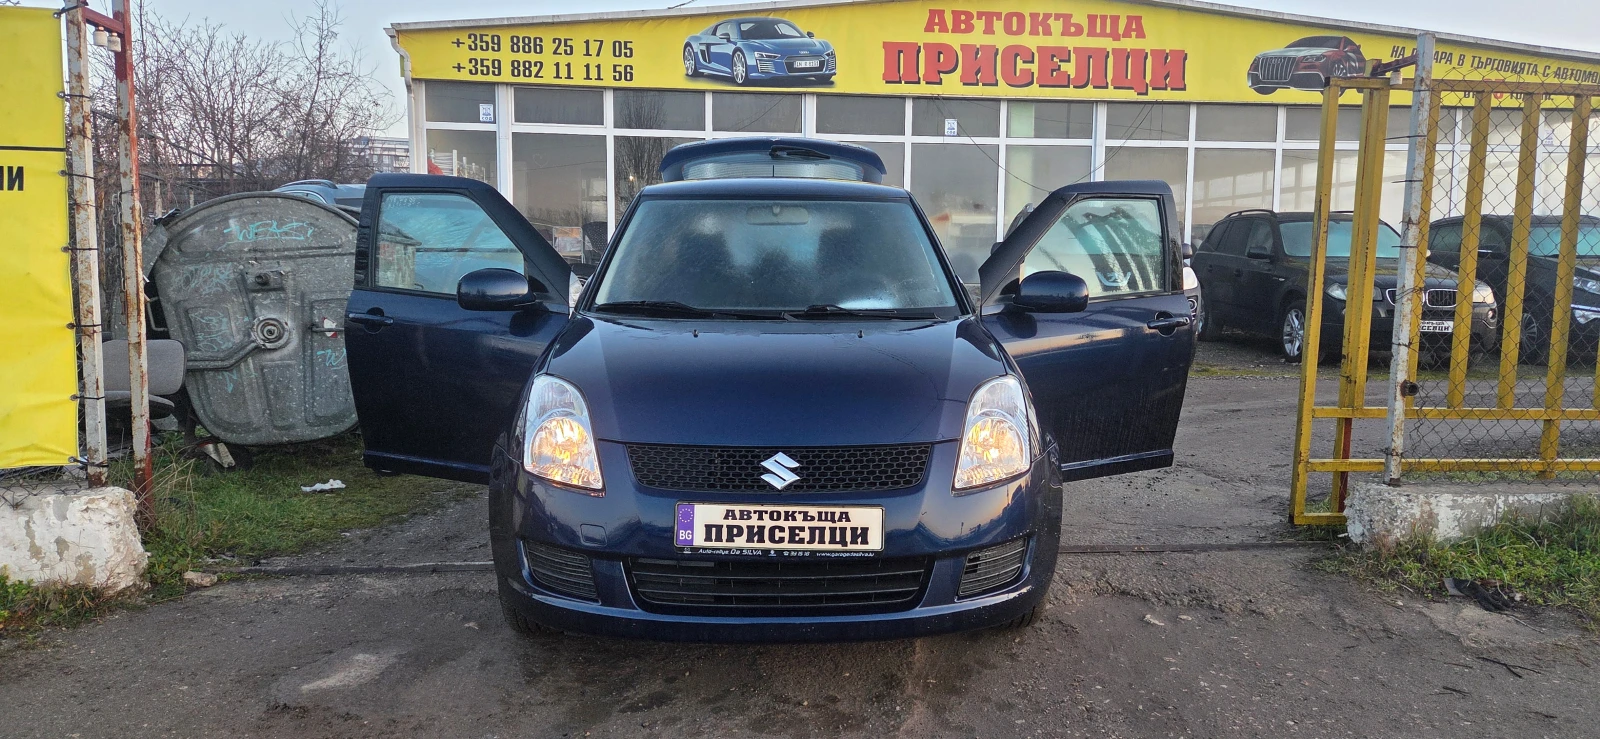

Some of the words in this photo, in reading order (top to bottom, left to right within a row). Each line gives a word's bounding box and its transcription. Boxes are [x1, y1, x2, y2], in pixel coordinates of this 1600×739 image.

[924, 9, 1147, 41] АВТОКЪЩА
[451, 33, 501, 52] +359
[510, 35, 544, 54] 886
[552, 38, 574, 56] 25
[583, 39, 604, 57] 17
[612, 40, 634, 58] 05
[452, 58, 501, 76] +359
[510, 60, 544, 78] 882
[553, 62, 574, 79] 11
[583, 63, 604, 81] 11
[612, 64, 634, 81] 56
[882, 41, 1187, 96] ПРИСЕЛЦИ
[1390, 45, 1406, 59] НА
[1457, 53, 1466, 66] В
[1470, 55, 1538, 76] ТЪРГОВИЯТА
[1542, 65, 1551, 77] С
[1553, 66, 1600, 84] АВТОМО
[723, 509, 851, 523] АВТОКЪЩА
[679, 530, 692, 540] BG
[704, 524, 869, 547] ПРИСЕЛЦИ
